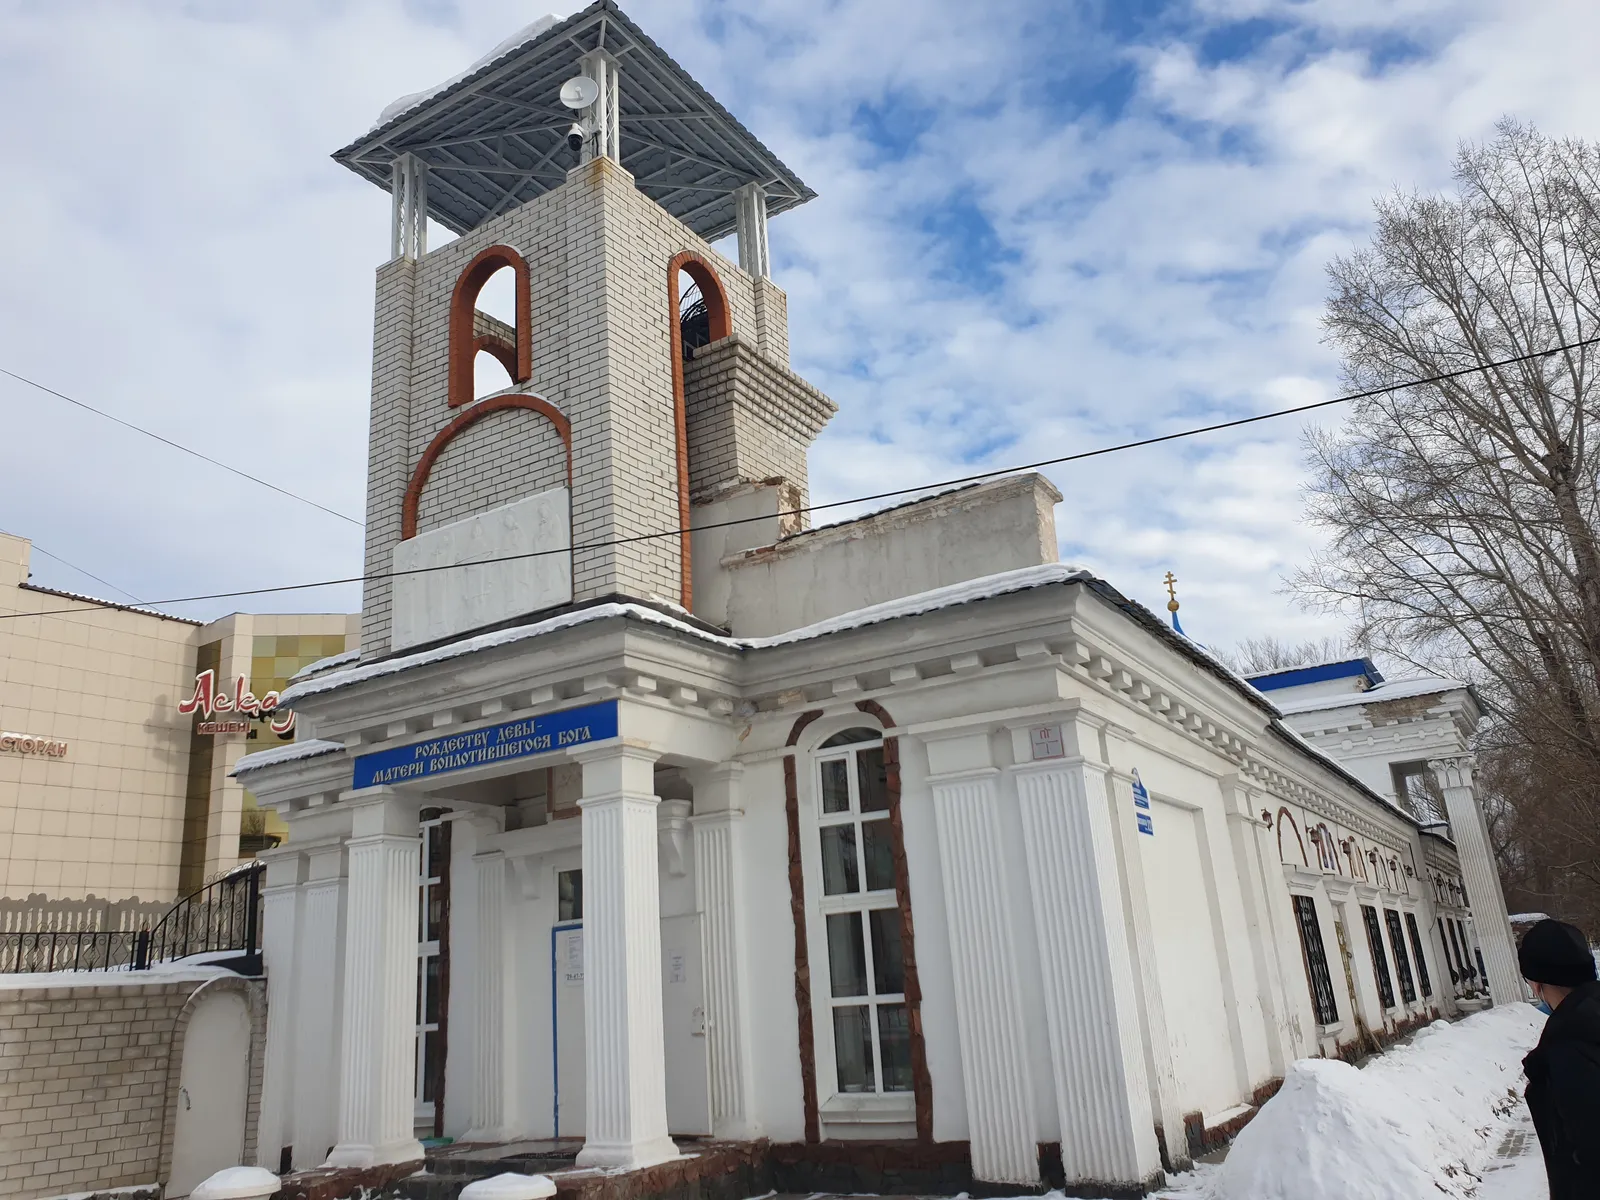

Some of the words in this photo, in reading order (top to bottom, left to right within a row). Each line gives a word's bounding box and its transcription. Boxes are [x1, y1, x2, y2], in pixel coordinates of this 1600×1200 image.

[372, 762, 425, 784] МАТЕРИ
[429, 733, 552, 772] ВОПЛОТИВШЕГОСЯ
[557, 725, 592, 746] БОГА
[414, 730, 490, 759] РОЖДЕСТВУ
